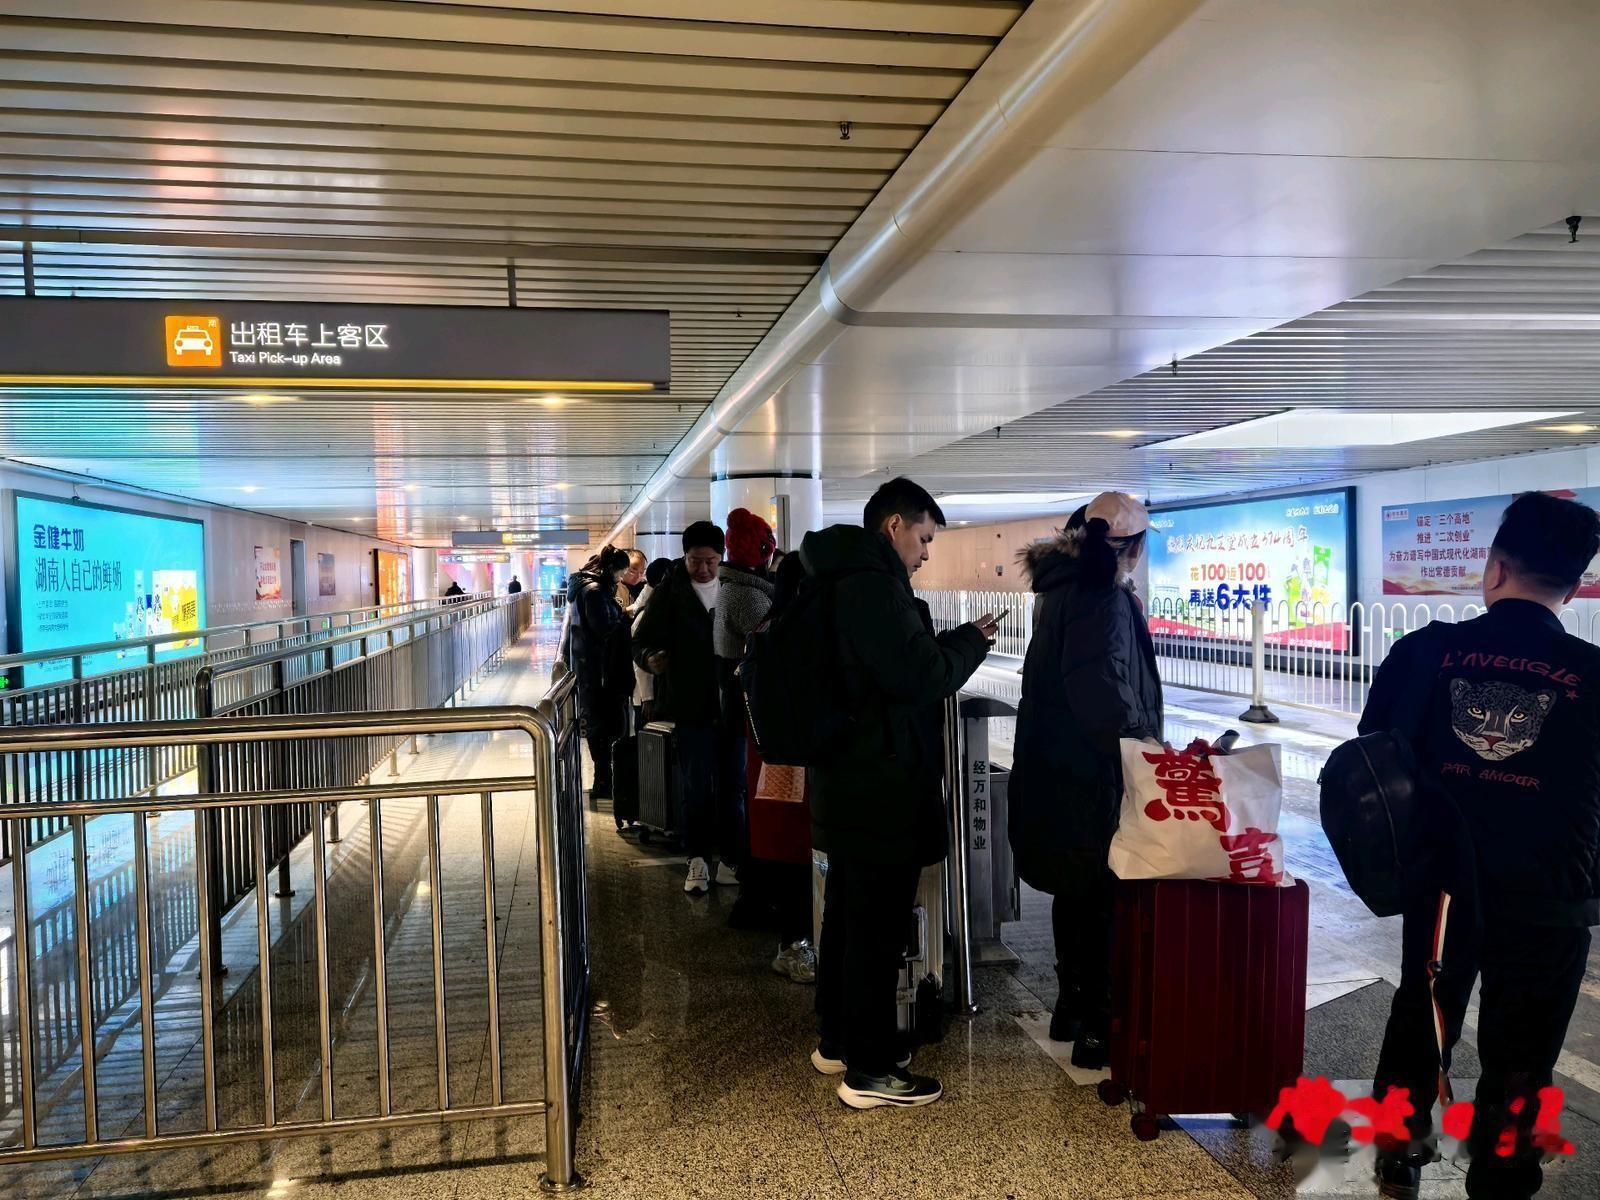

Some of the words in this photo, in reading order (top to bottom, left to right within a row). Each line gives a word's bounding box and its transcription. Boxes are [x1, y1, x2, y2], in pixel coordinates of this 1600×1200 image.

[230, 321, 389, 348] 出租车上客区
[229, 351, 256, 364] Taxi
[258, 352, 309, 366] Pick-up
[311, 354, 341, 365] Area
[33, 524, 85, 552] 金健牛奶
[35, 556, 122, 593] 湖南人自己的鲜奶
[972, 760, 987, 851] 经万和物业
